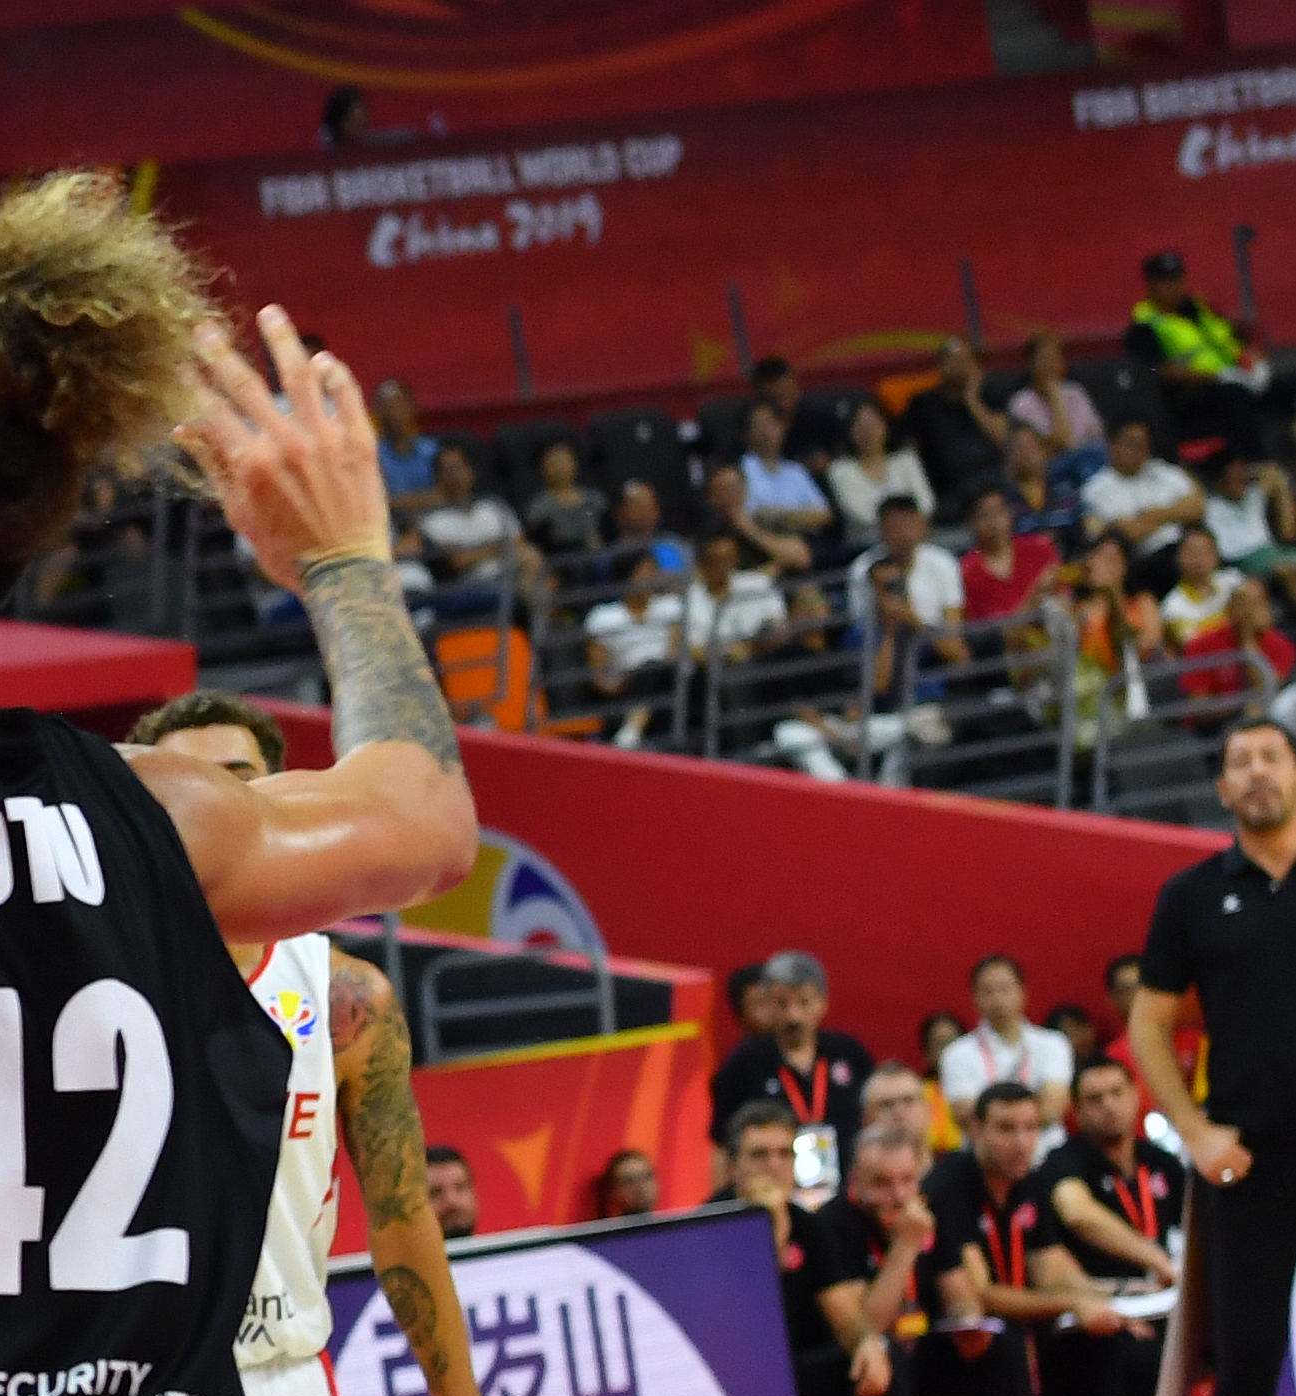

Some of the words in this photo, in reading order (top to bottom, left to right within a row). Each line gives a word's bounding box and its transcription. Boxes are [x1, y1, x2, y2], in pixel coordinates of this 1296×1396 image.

[332, 152, 516, 210] BASKETBALL
[515, 137, 622, 189] WORLD
[621, 132, 685, 180] CUP
[366, 210, 499, 268] China
